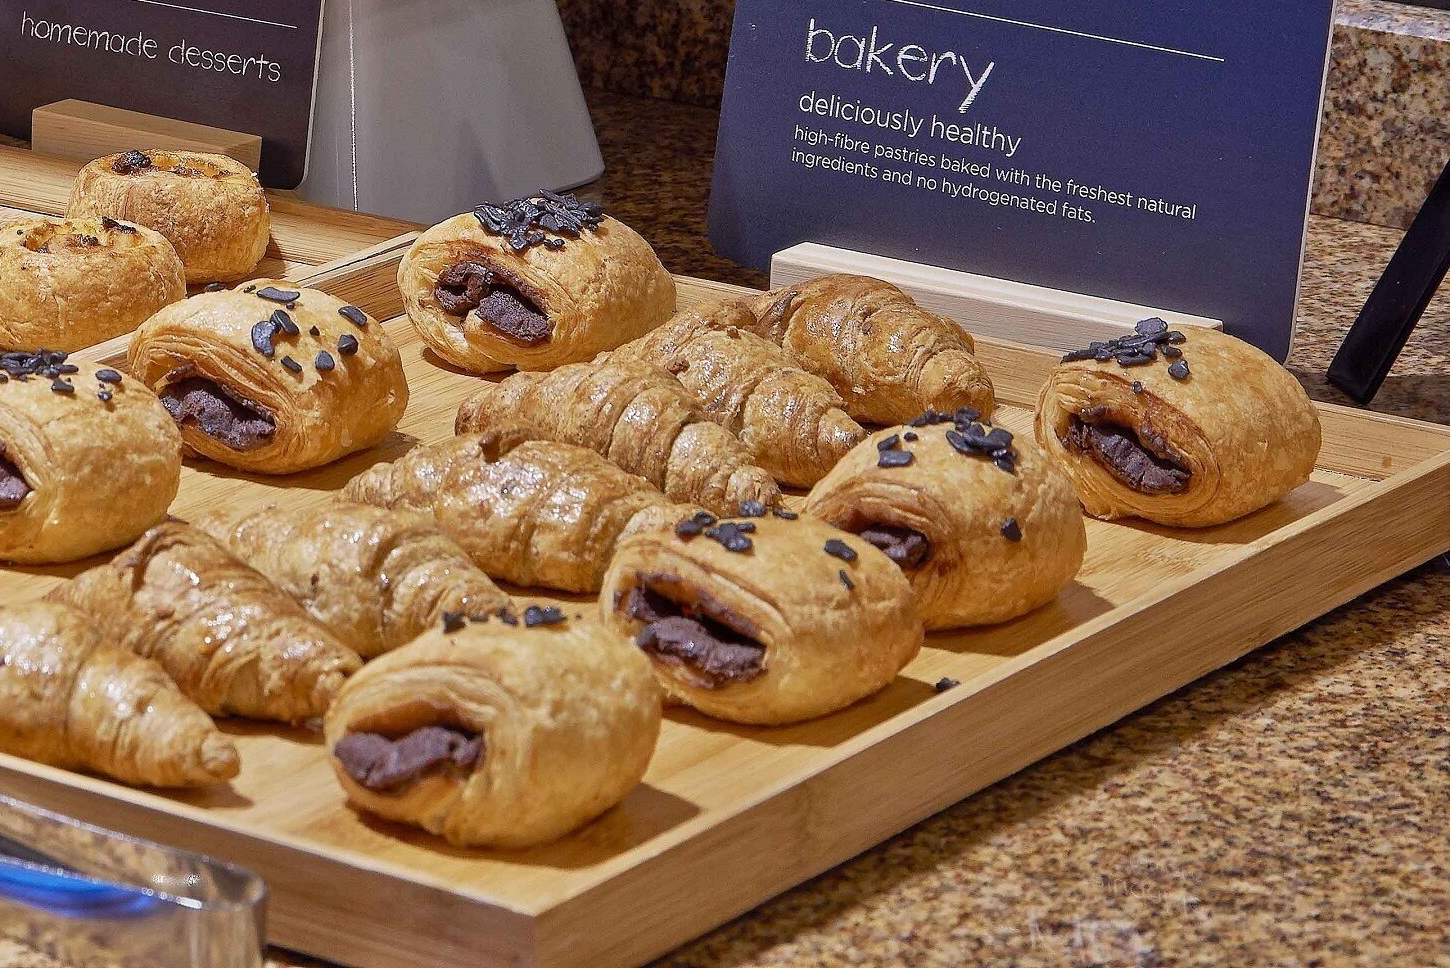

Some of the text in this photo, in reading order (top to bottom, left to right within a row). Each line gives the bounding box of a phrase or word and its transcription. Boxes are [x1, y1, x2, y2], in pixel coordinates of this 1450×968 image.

[22, 11, 280, 81] homemade desserts
[806, 19, 994, 113] bakery
[800, 91, 1021, 157] deliciously healthy
[792, 151, 1097, 225] ingredients and no hydrogenated fats.
[795, 125, 1196, 219] high-fibre pastries baked with the freshest natural
